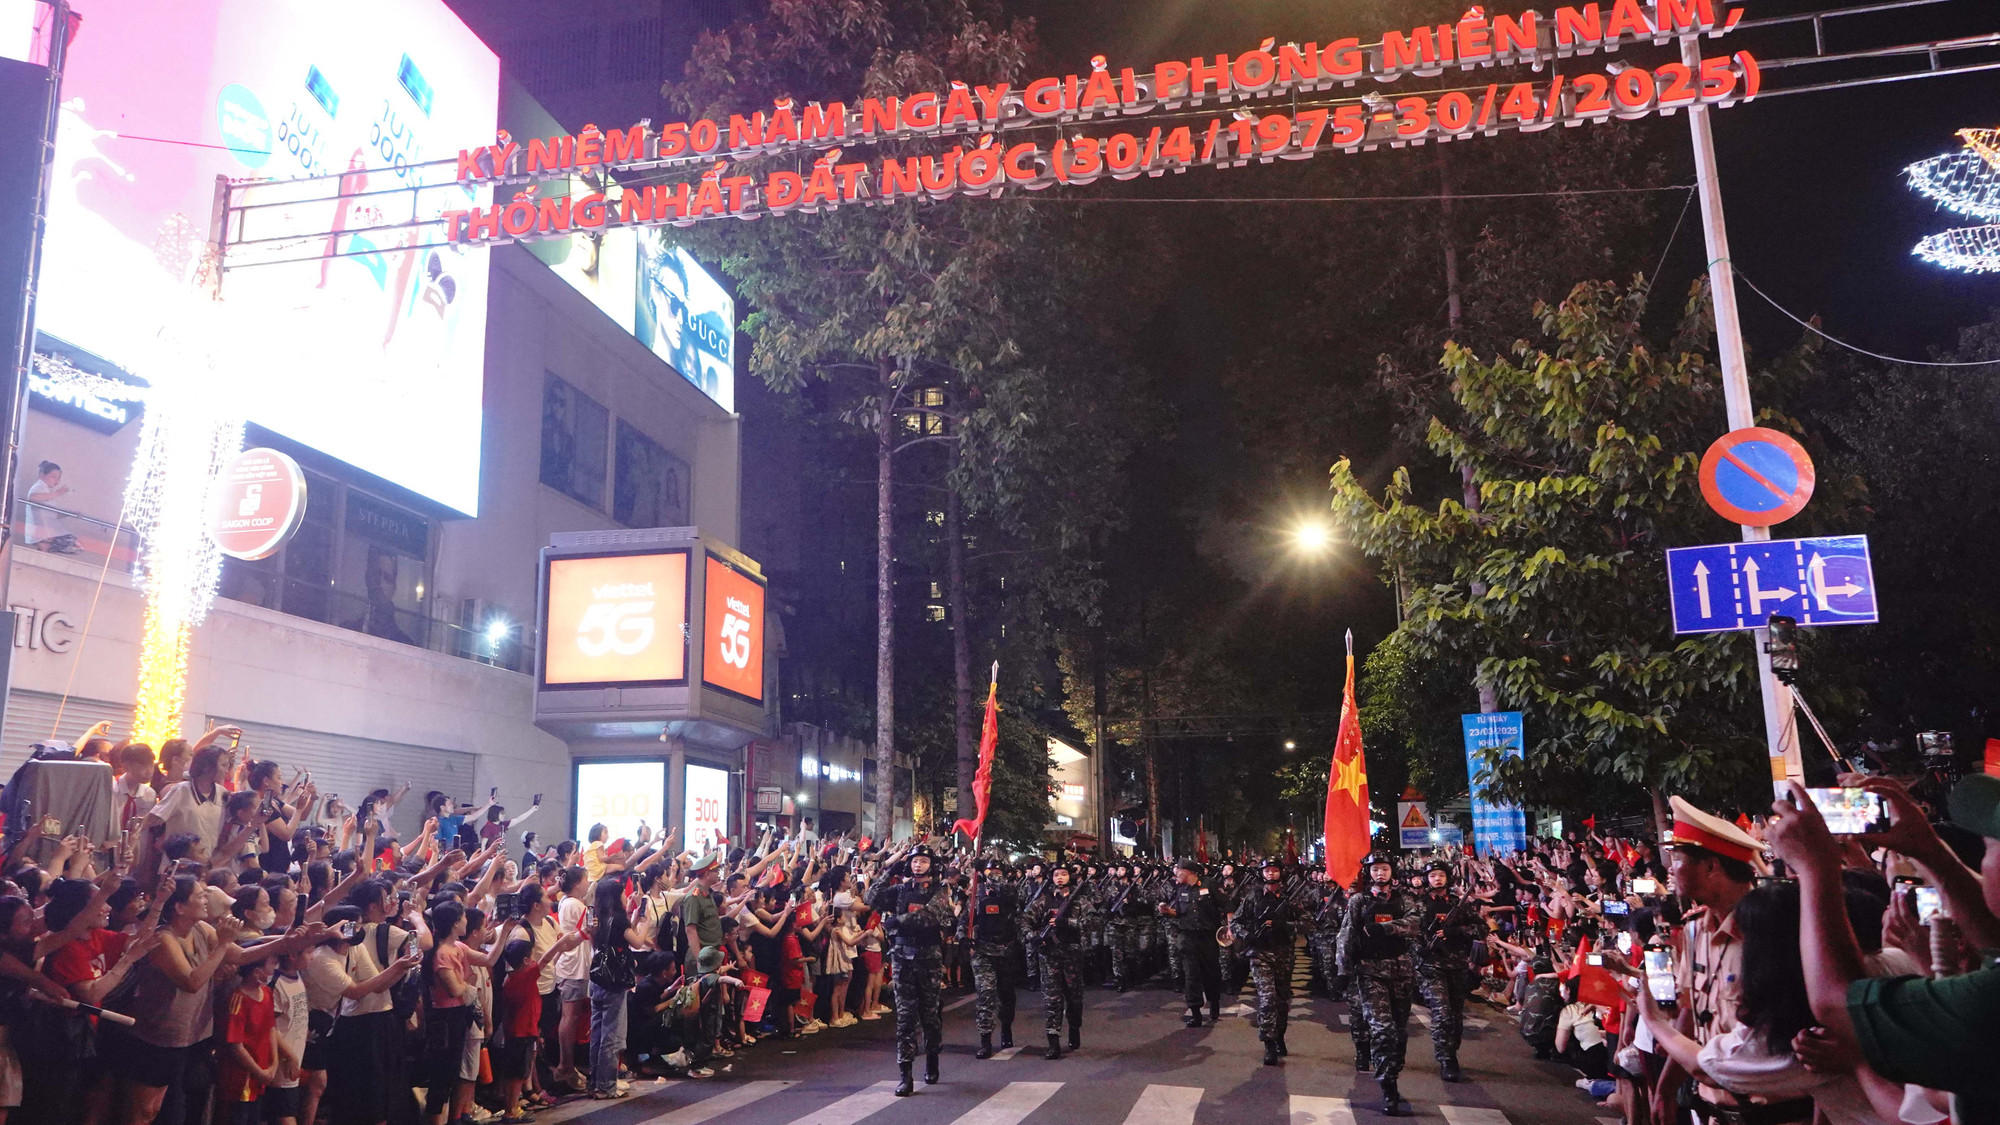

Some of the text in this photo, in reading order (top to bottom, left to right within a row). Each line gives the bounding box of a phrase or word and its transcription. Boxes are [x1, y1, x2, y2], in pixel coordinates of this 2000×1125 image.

[457, 129, 520, 182] KỶ
[527, 123, 649, 177] NIỆM
[660, 118, 720, 157] 50
[729, 97, 846, 150] NĂM
[862, 80, 1011, 135] NGÀY
[1024, 55, 1137, 117] GIẢI
[1154, 37, 1364, 101] PHÓNG
[1382, 5, 1538, 70] MIỀN
[441, 185, 608, 243] THỐNG
[620, 160, 754, 224] NHẤT
[765, 148, 868, 210] ĐẤT
[882, 133, 1039, 197] NƯỚC
[592, 581, 655, 598] viettel
[726, 596, 751, 618] viettel
[577, 601, 655, 656] 5G
[720, 613, 751, 669] 5G
[591, 793, 650, 817] 300
[695, 797, 719, 823] 300
